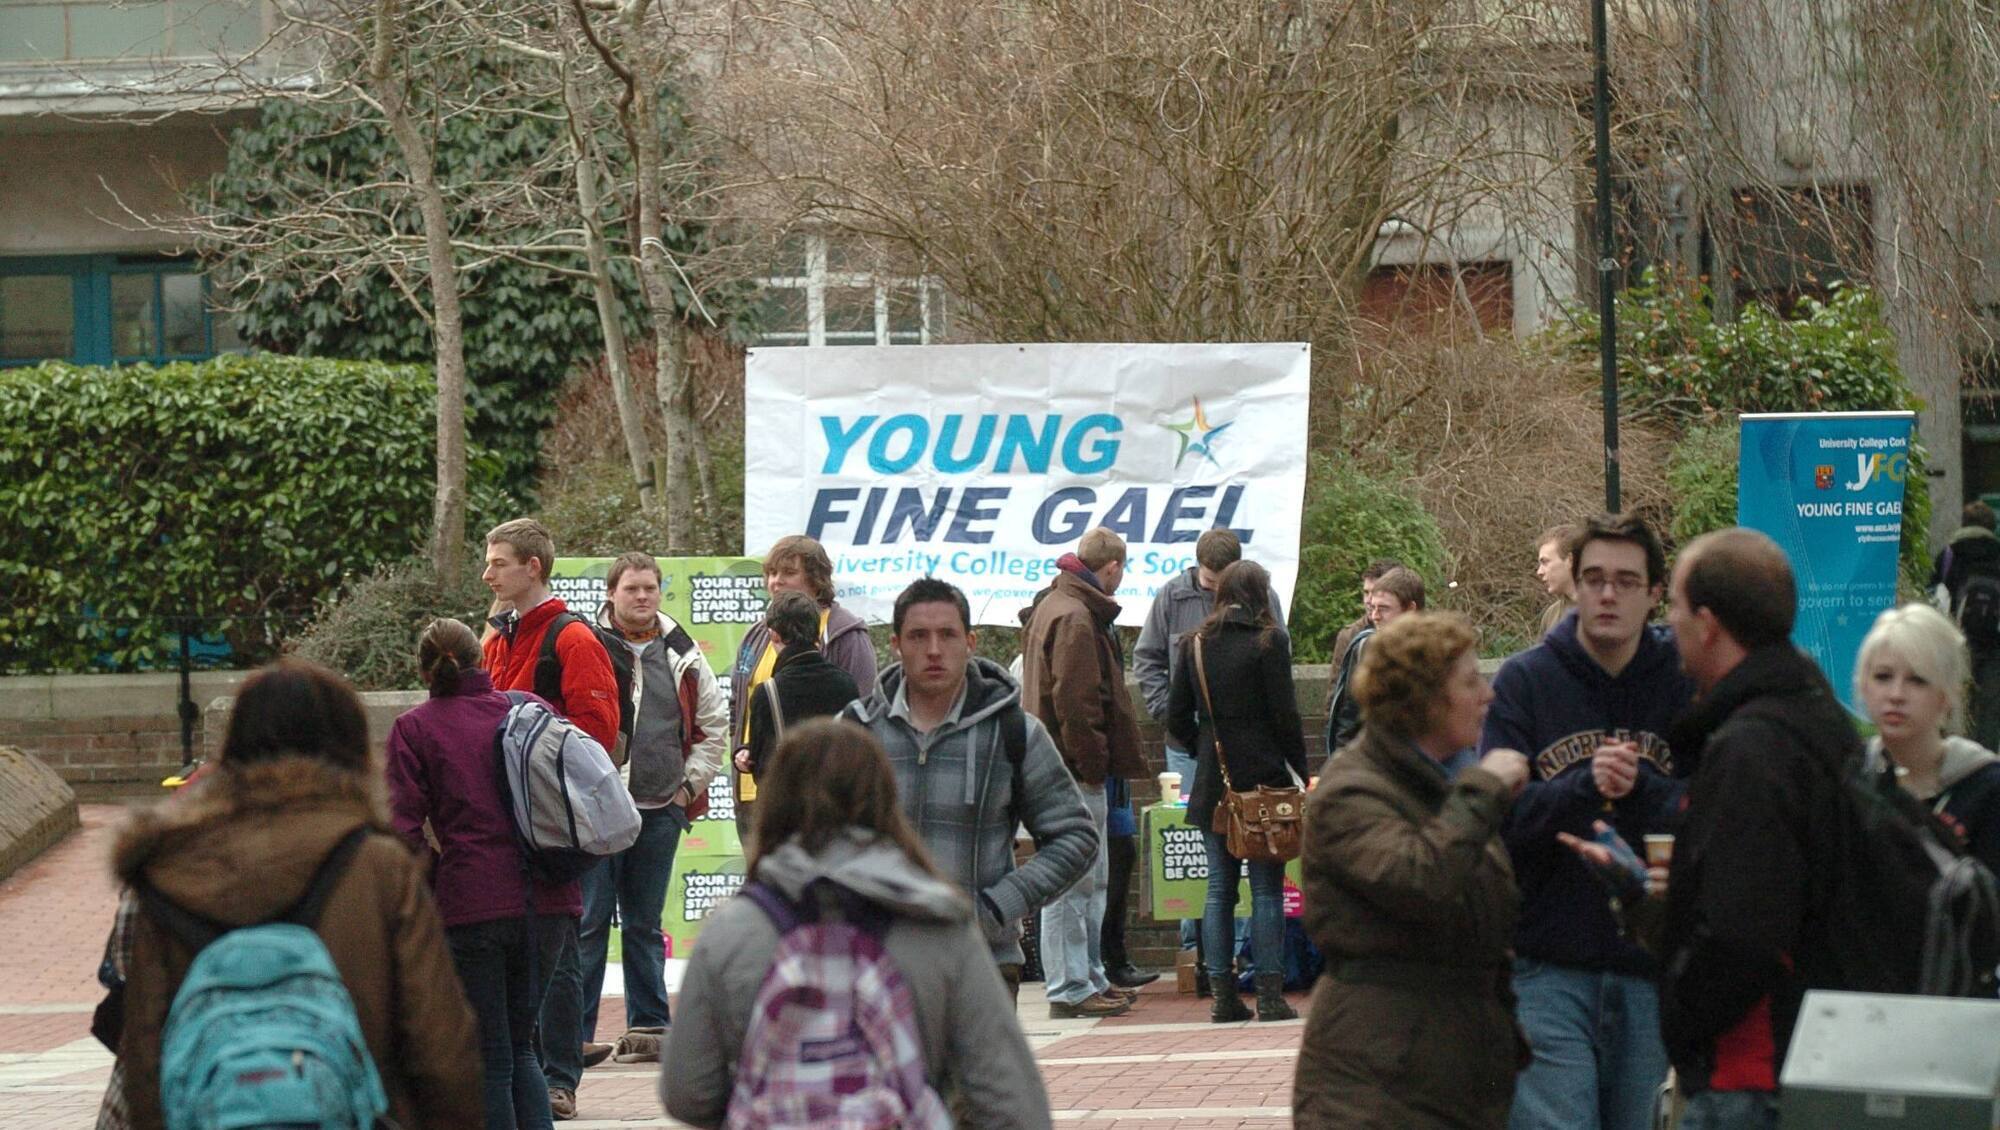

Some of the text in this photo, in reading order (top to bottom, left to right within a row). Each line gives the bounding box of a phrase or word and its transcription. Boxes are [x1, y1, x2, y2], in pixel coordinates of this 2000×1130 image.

[818, 413, 1124, 475] YOUNG
[1819, 438, 1857, 449] University
[1859, 437, 1888, 449] College
[1796, 502, 1842, 517] YOUNG
[1844, 501, 1873, 516] FINE
[805, 485, 1255, 546] FINE GAEL
[832, 549, 942, 576] iversity
[950, 550, 1058, 581] College
[550, 579, 589, 590] YOUR
[692, 577, 732, 588] YOUR
[692, 589, 754, 600] COUNTS.
[692, 600, 764, 611] STAND UP
[1798, 595, 1845, 611] govern
[1849, 594, 1864, 607] to
[692, 611, 766, 623] BE COUNT
[1163, 830, 1204, 842] YOUR
[1165, 867, 1184, 879] BE
[686, 875, 725, 886] YOUR
[685, 909, 703, 920] BE
